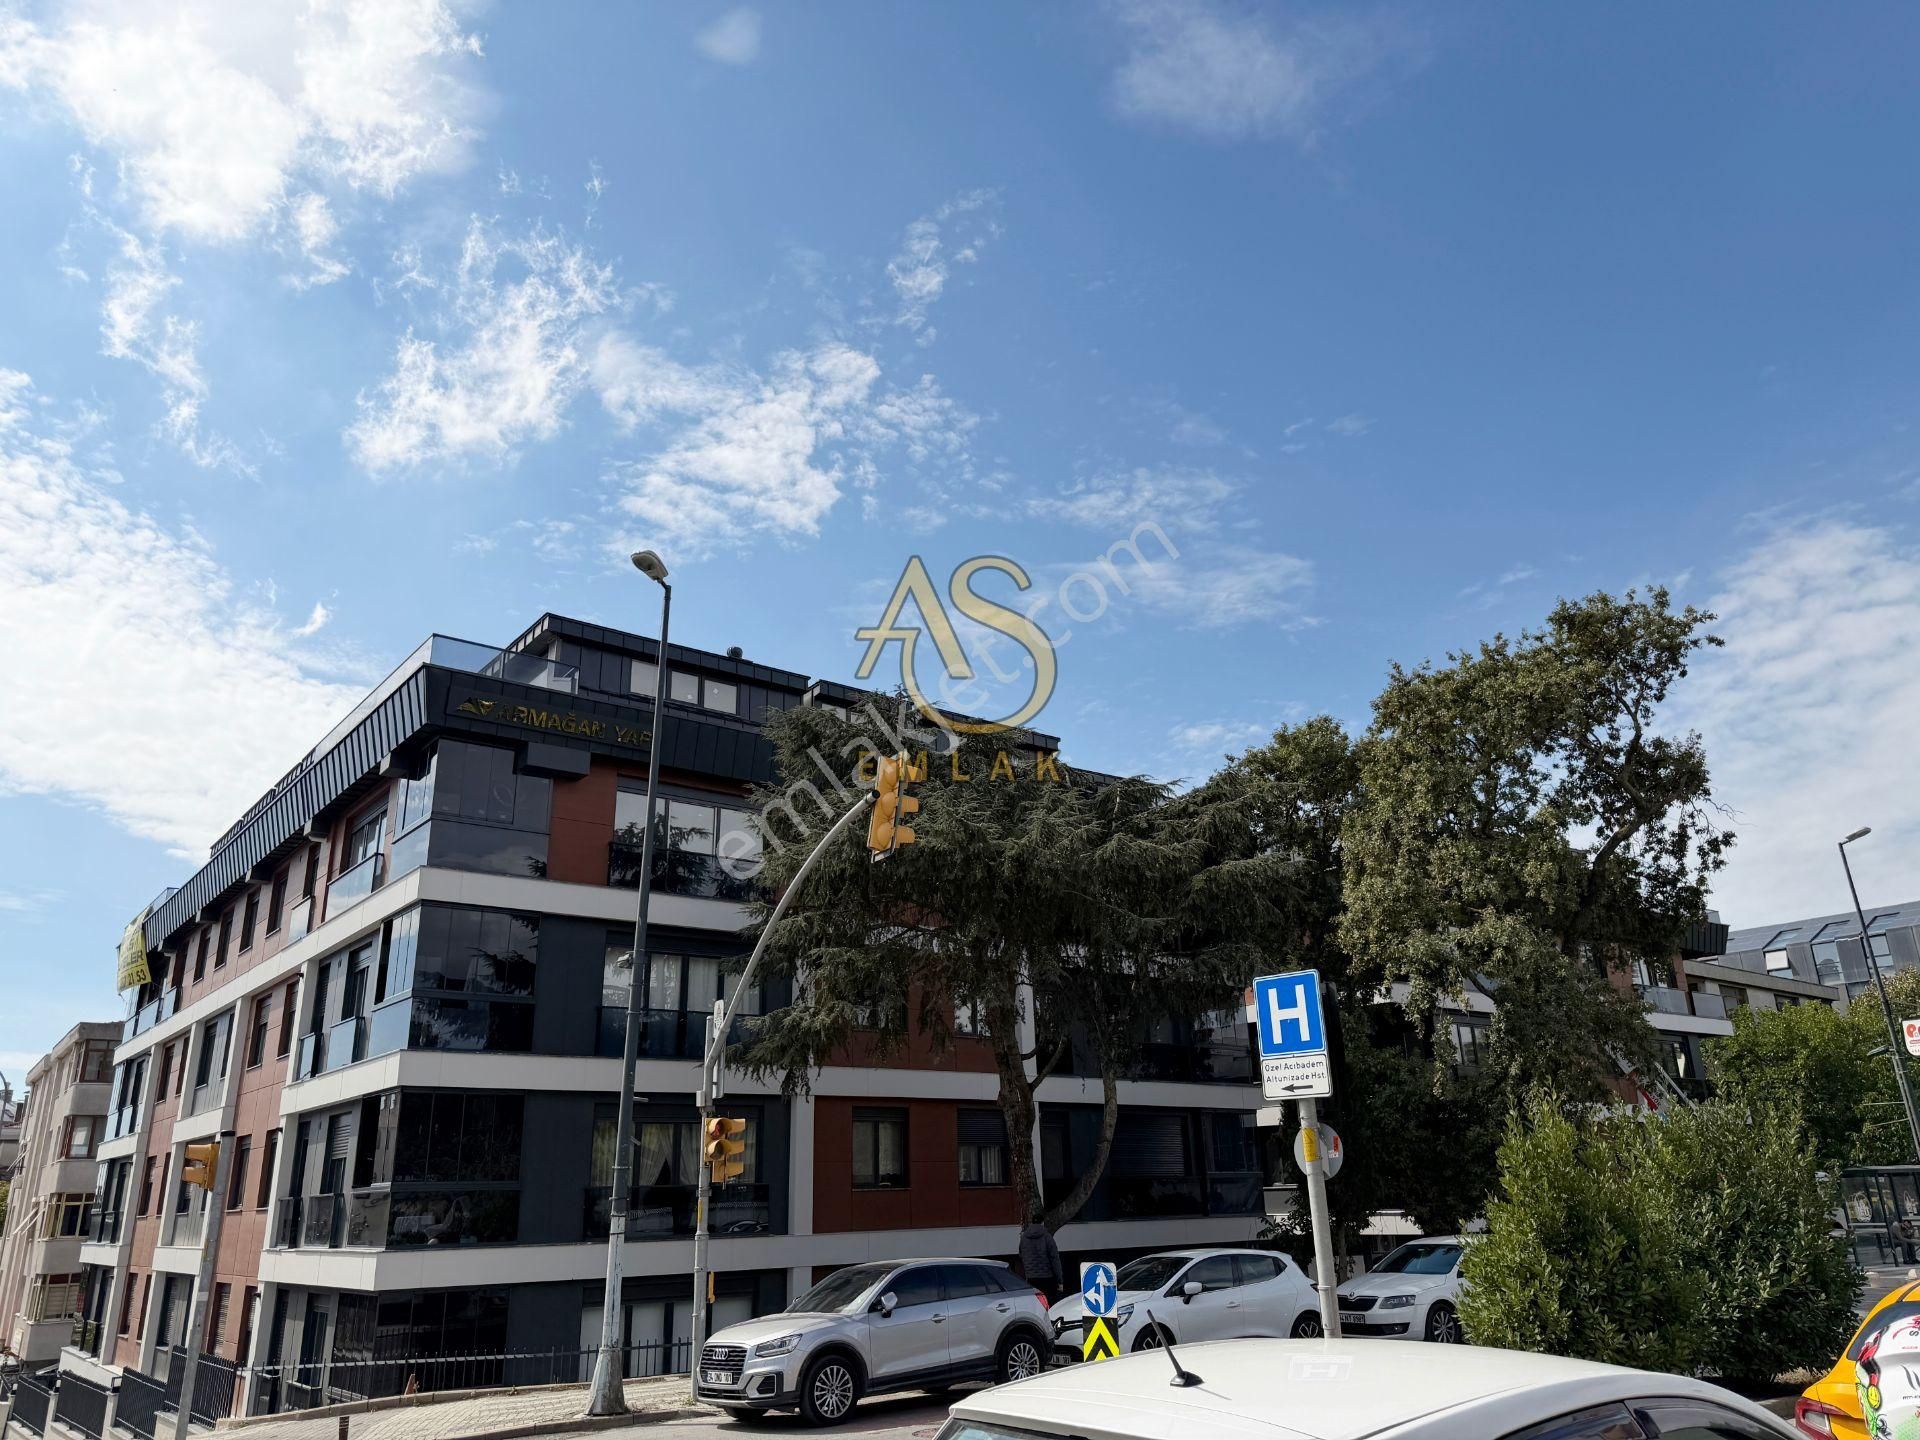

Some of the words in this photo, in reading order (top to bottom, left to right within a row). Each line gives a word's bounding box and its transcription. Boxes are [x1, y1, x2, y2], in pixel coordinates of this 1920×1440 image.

[615, 725, 653, 745] YAP
[1268, 984, 1311, 1045] H
[1266, 1073, 1310, 1083] Altunizade
